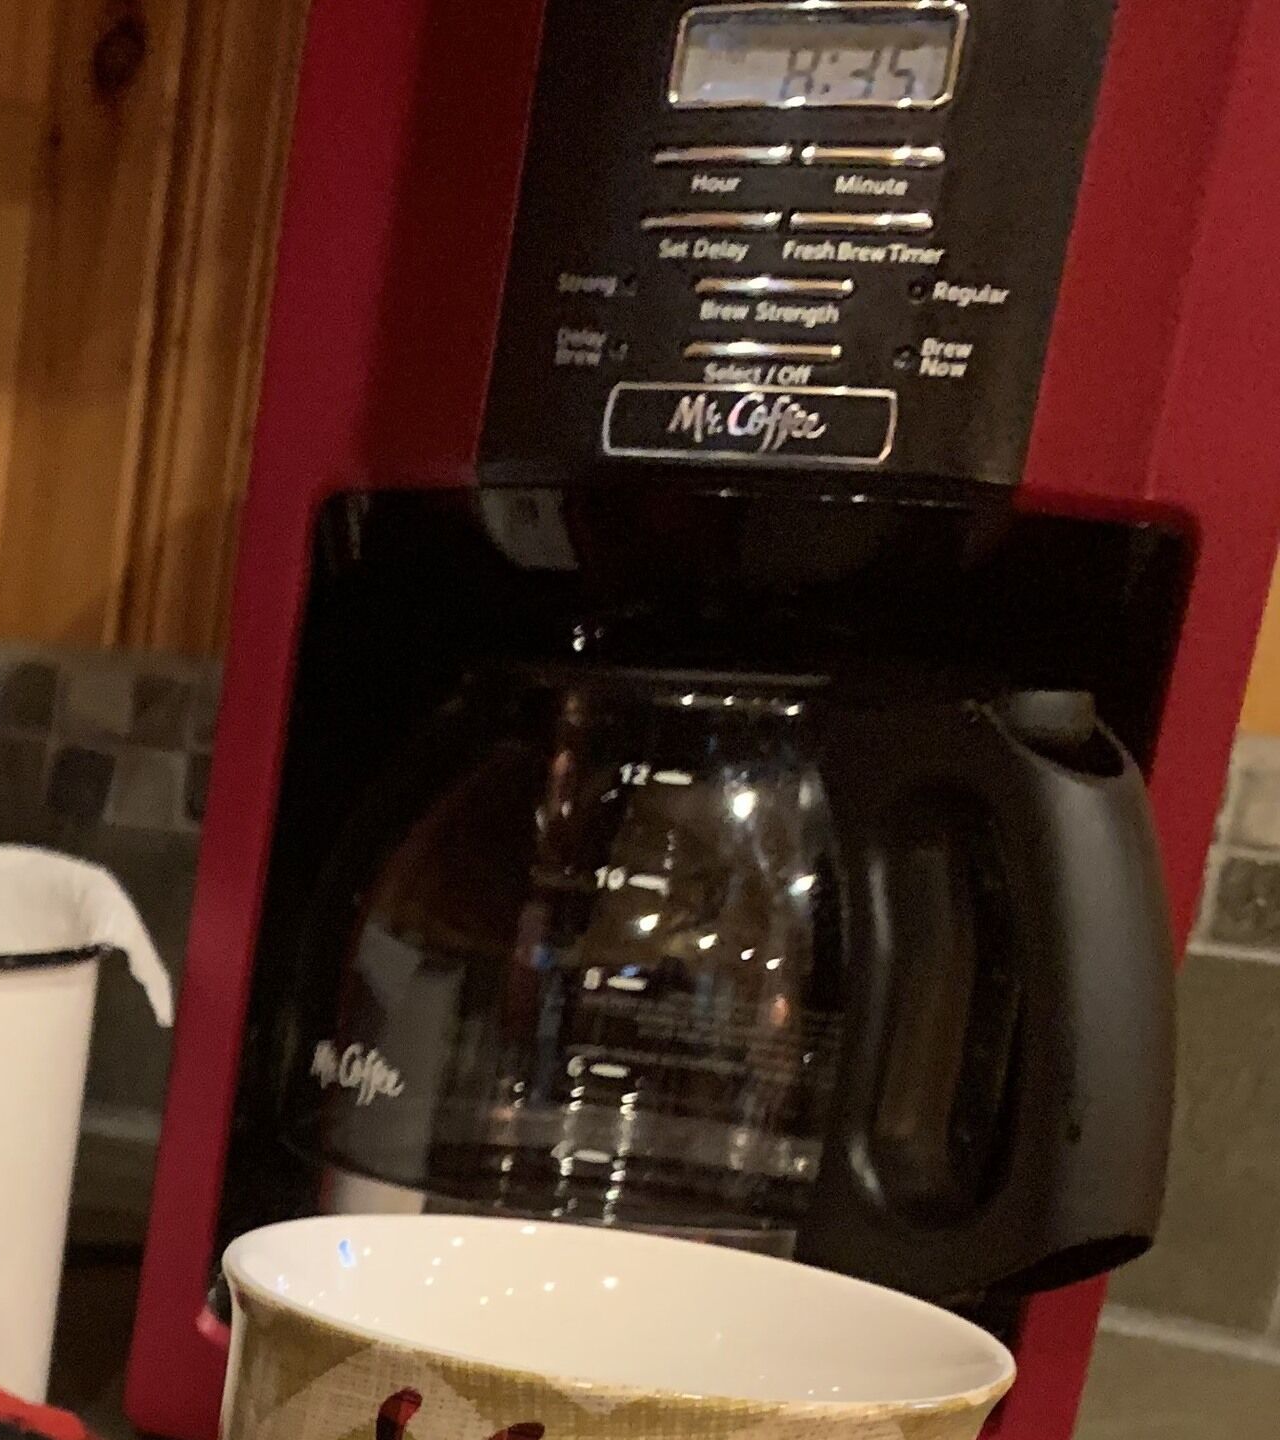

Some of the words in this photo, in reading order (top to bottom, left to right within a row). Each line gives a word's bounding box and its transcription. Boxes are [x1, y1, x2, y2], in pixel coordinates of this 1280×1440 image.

[691, 175, 741, 193] Hour
[834, 175, 909, 196] Minute
[658, 238, 689, 259] Set
[692, 238, 750, 263] Delay
[782, 240, 836, 262] Fresh
[837, 241, 887, 263] Brew
[887, 243, 945, 265] Timer
[932, 280, 1010, 307] Regular
[700, 299, 750, 322] Brew
[754, 300, 840, 328] Strength
[920, 337, 975, 358] Brew
[920, 357, 968, 377] Now
[726, 391, 829, 452] Coffee
[618, 762, 652, 786] 12
[594, 864, 628, 892] 10
